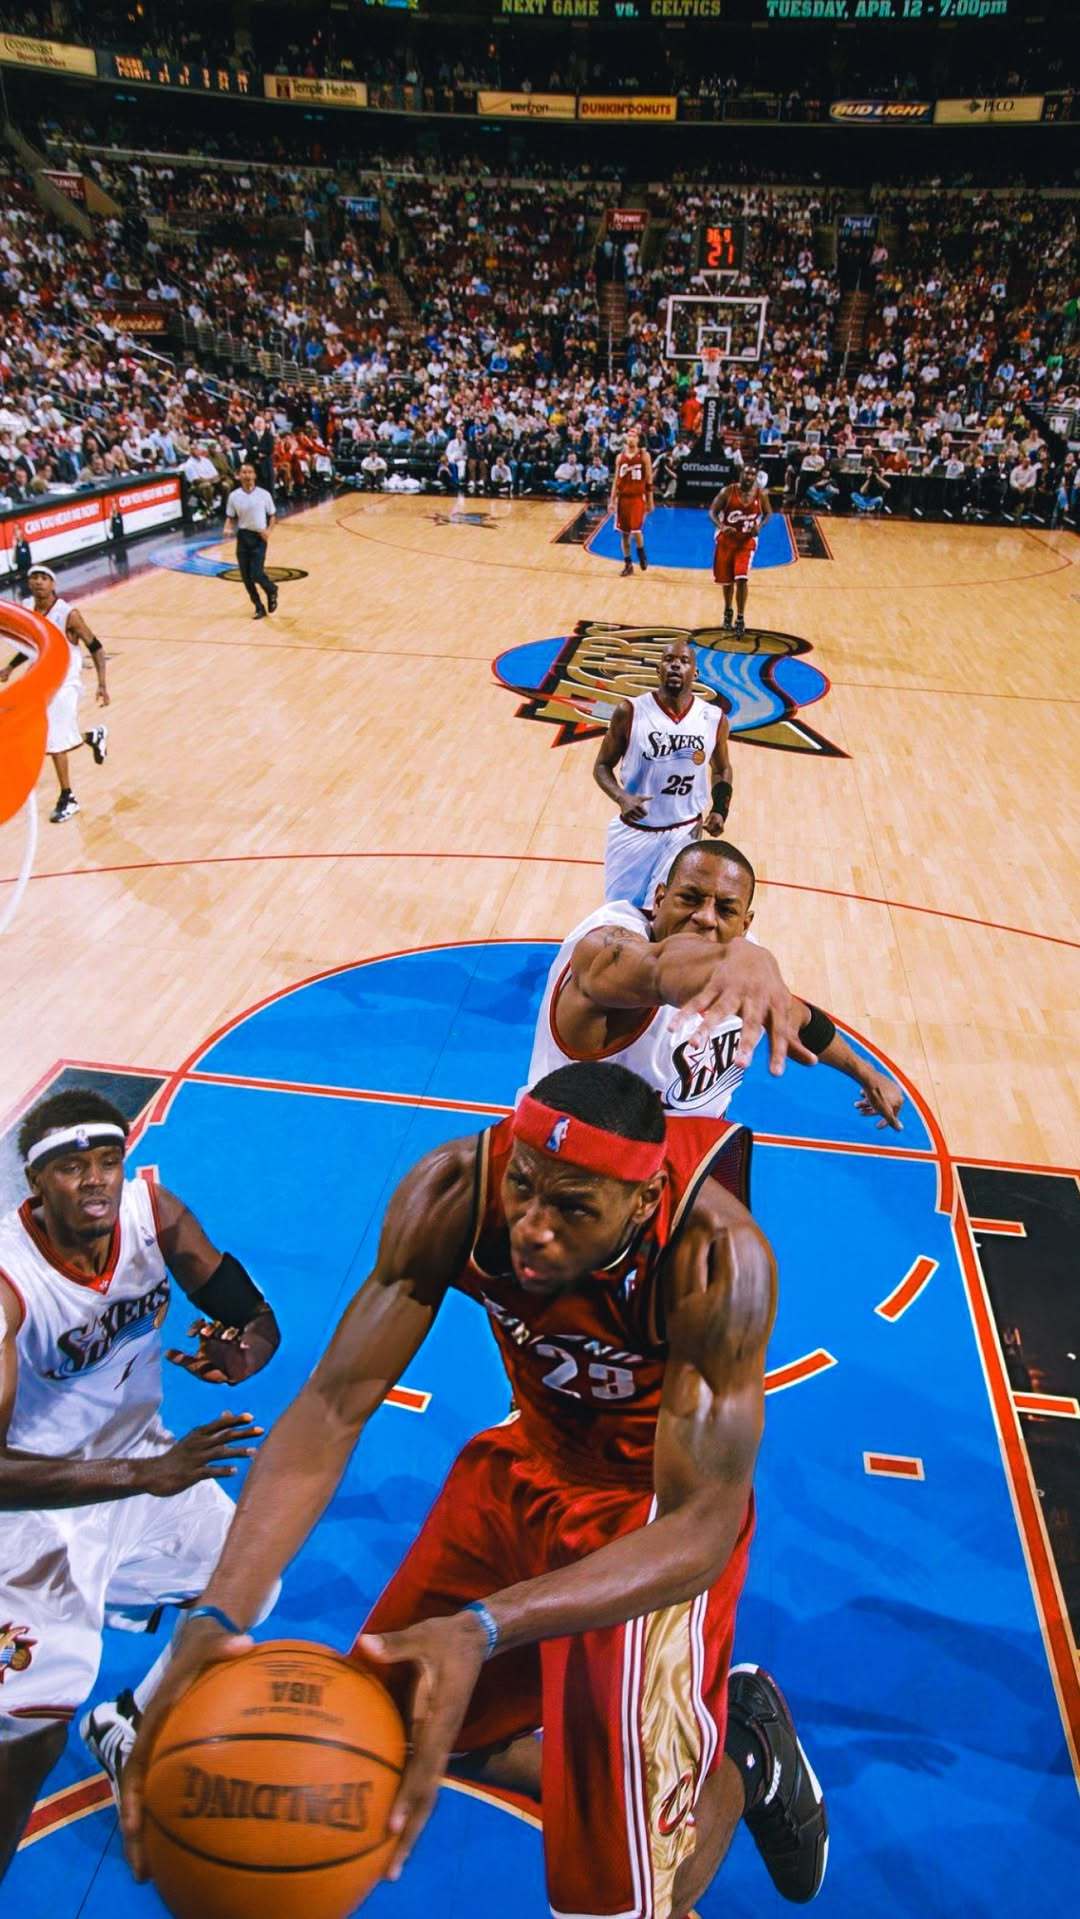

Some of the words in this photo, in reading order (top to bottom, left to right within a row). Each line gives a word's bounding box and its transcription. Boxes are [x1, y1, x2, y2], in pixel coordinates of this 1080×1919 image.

[502, 0, 546, 14] NEXT
[552, 0, 599, 16] GAME
[651, 0, 721, 16] CELTICS
[767, 1, 849, 19] TUESDAY,
[855, 1, 896, 17] APR.
[902, 1, 923, 17] 12
[939, 0, 1007, 17] 7:00pm
[293, 80, 324, 98] Temple
[326, 82, 358, 99] Health
[511, 102, 549, 115] verizon
[833, 103, 873, 116] BUD
[874, 103, 929, 118] LIGHT
[681, 462, 731, 473] OfficeMax
[642, 731, 705, 761] SIXERS
[660, 774, 695, 796] 25
[541, 1343, 637, 1400] 23
[179, 1762, 375, 1833] SPALDING
